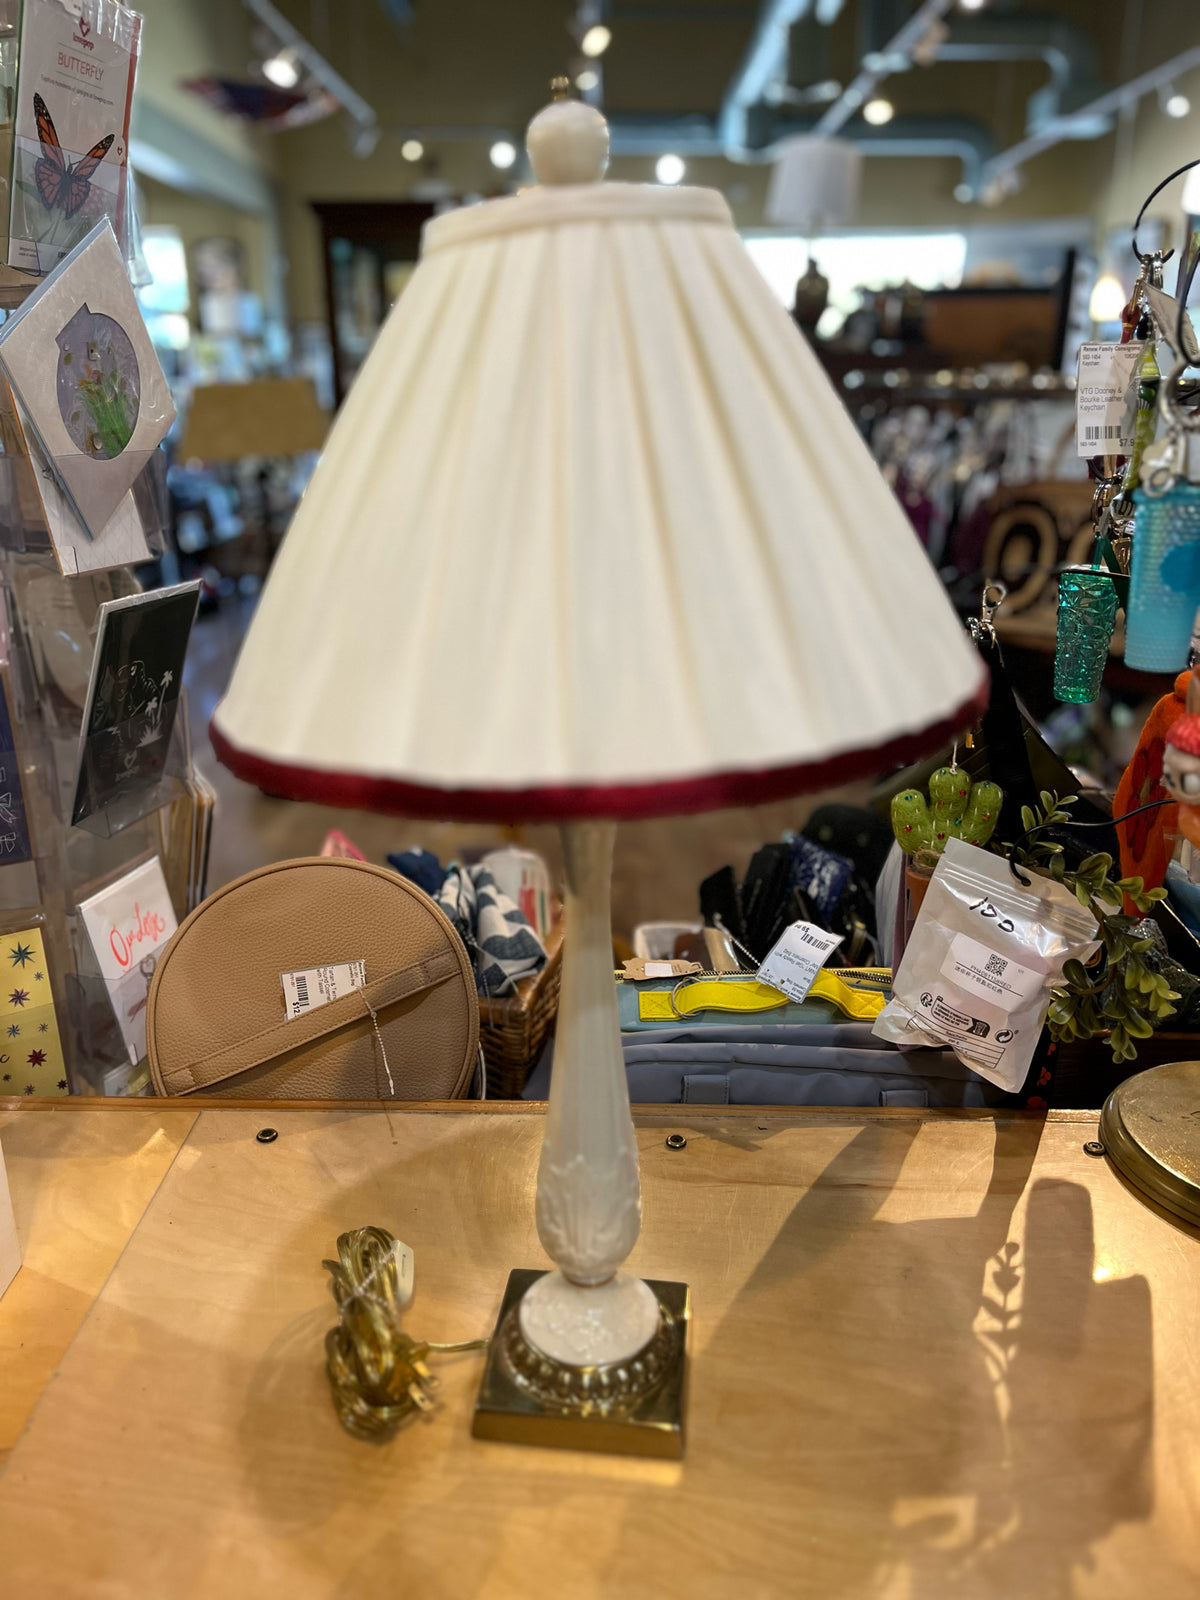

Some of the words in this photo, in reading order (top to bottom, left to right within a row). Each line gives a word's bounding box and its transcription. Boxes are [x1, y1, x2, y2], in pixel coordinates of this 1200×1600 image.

[57, 52, 104, 80] BUTTERFLY
[1080, 387, 1093, 395] VTG
[1095, 387, 1117, 396] Dooney
[1080, 404, 1106, 413] Keychain
